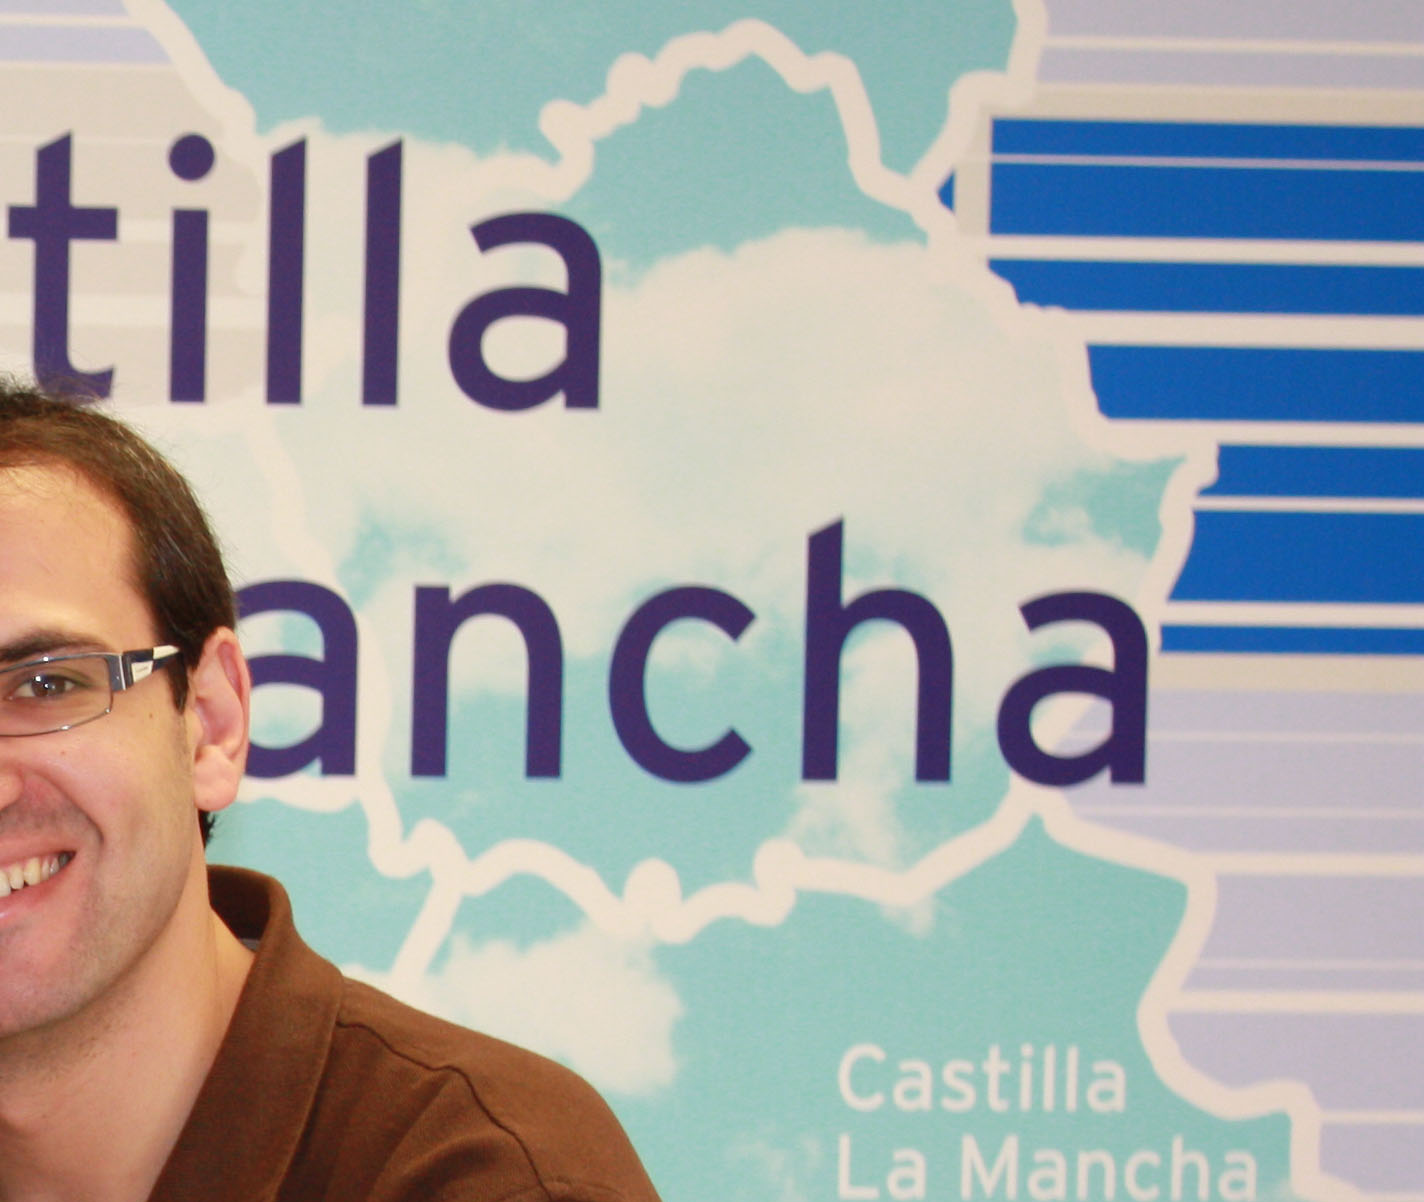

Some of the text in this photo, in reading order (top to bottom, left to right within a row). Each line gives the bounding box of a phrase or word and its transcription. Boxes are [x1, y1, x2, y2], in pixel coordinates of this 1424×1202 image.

[235, 517, 1148, 786] ancha
[837, 1043, 1128, 1113] Castilla
[837, 1133, 1258, 1202] La Mancha
